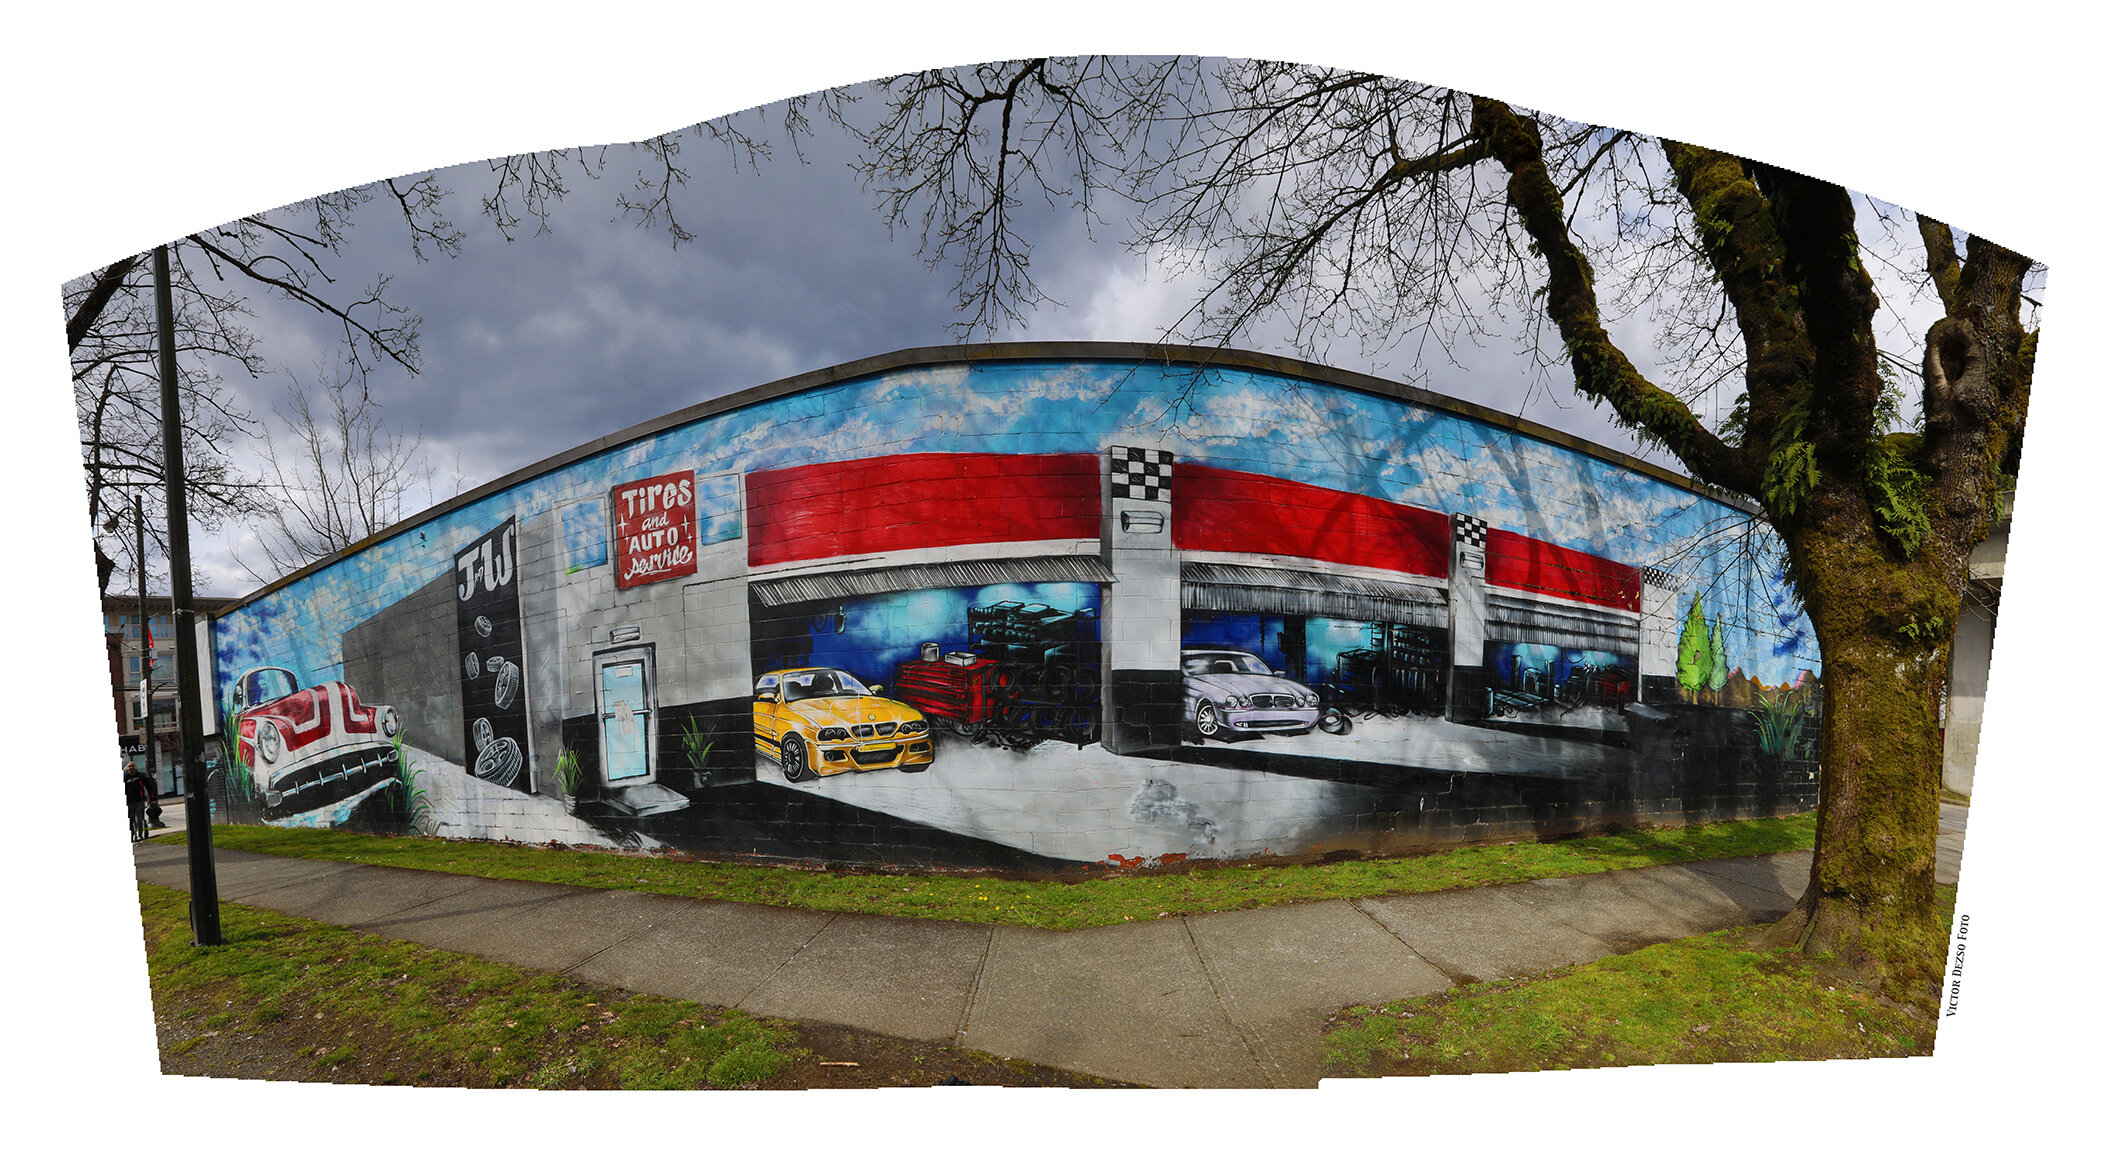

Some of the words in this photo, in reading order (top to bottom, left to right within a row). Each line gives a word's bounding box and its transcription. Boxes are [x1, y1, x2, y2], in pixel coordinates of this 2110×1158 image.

[622, 479, 693, 519] Tires
[641, 512, 670, 531] and
[628, 527, 679, 555] AUTO
[623, 545, 693, 580] service
